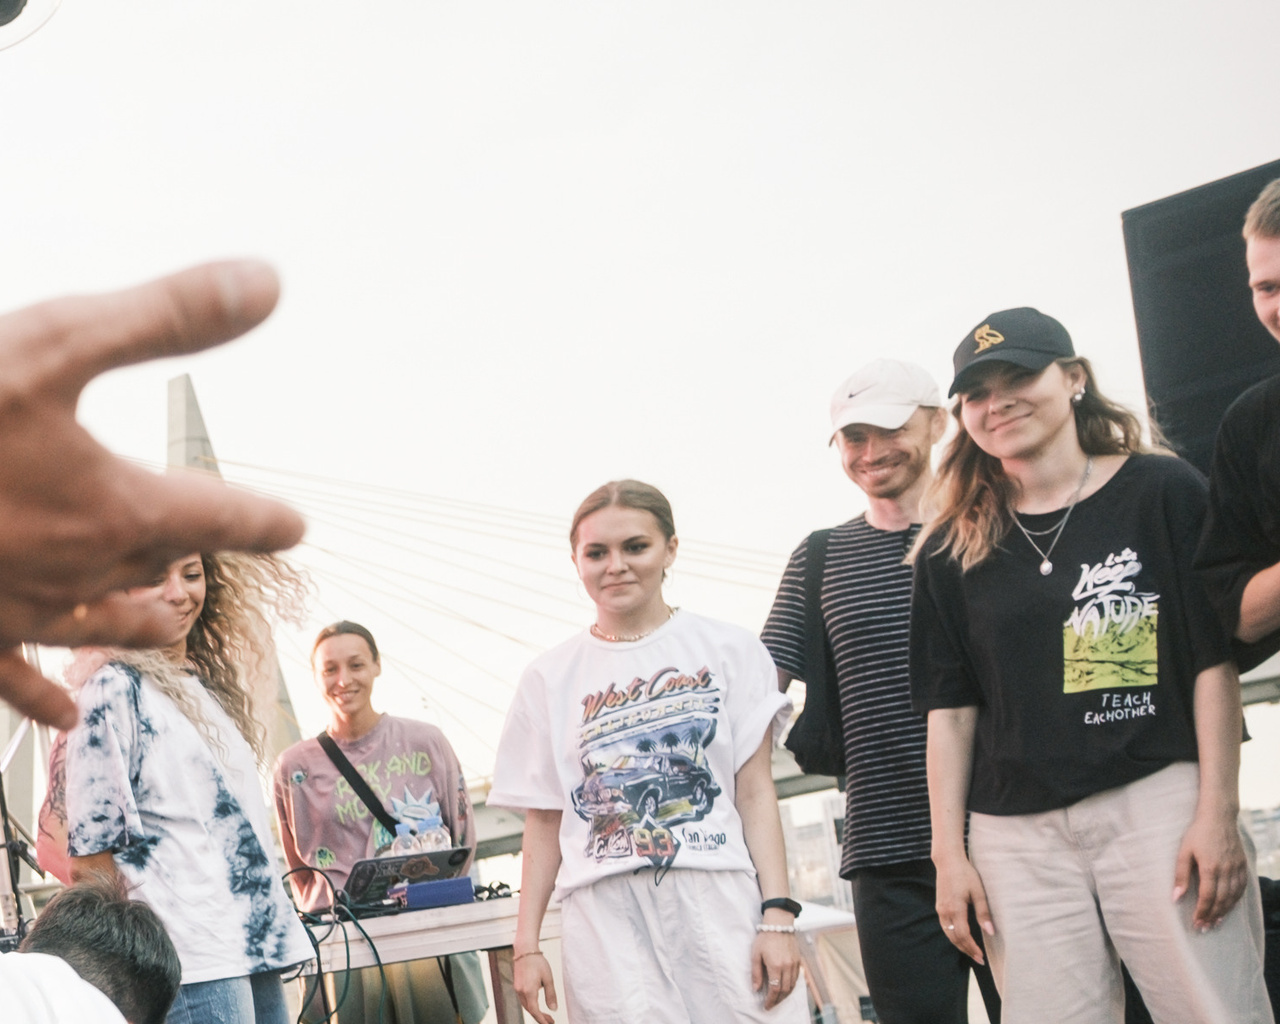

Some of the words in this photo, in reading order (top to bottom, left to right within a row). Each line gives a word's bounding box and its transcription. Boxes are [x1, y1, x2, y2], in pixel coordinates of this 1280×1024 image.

[581, 677, 646, 722] West
[645, 666, 714, 701] Coast
[1101, 692, 1152, 708] TEACH
[385, 752, 432, 779] AND
[634, 829, 675, 857] 93
